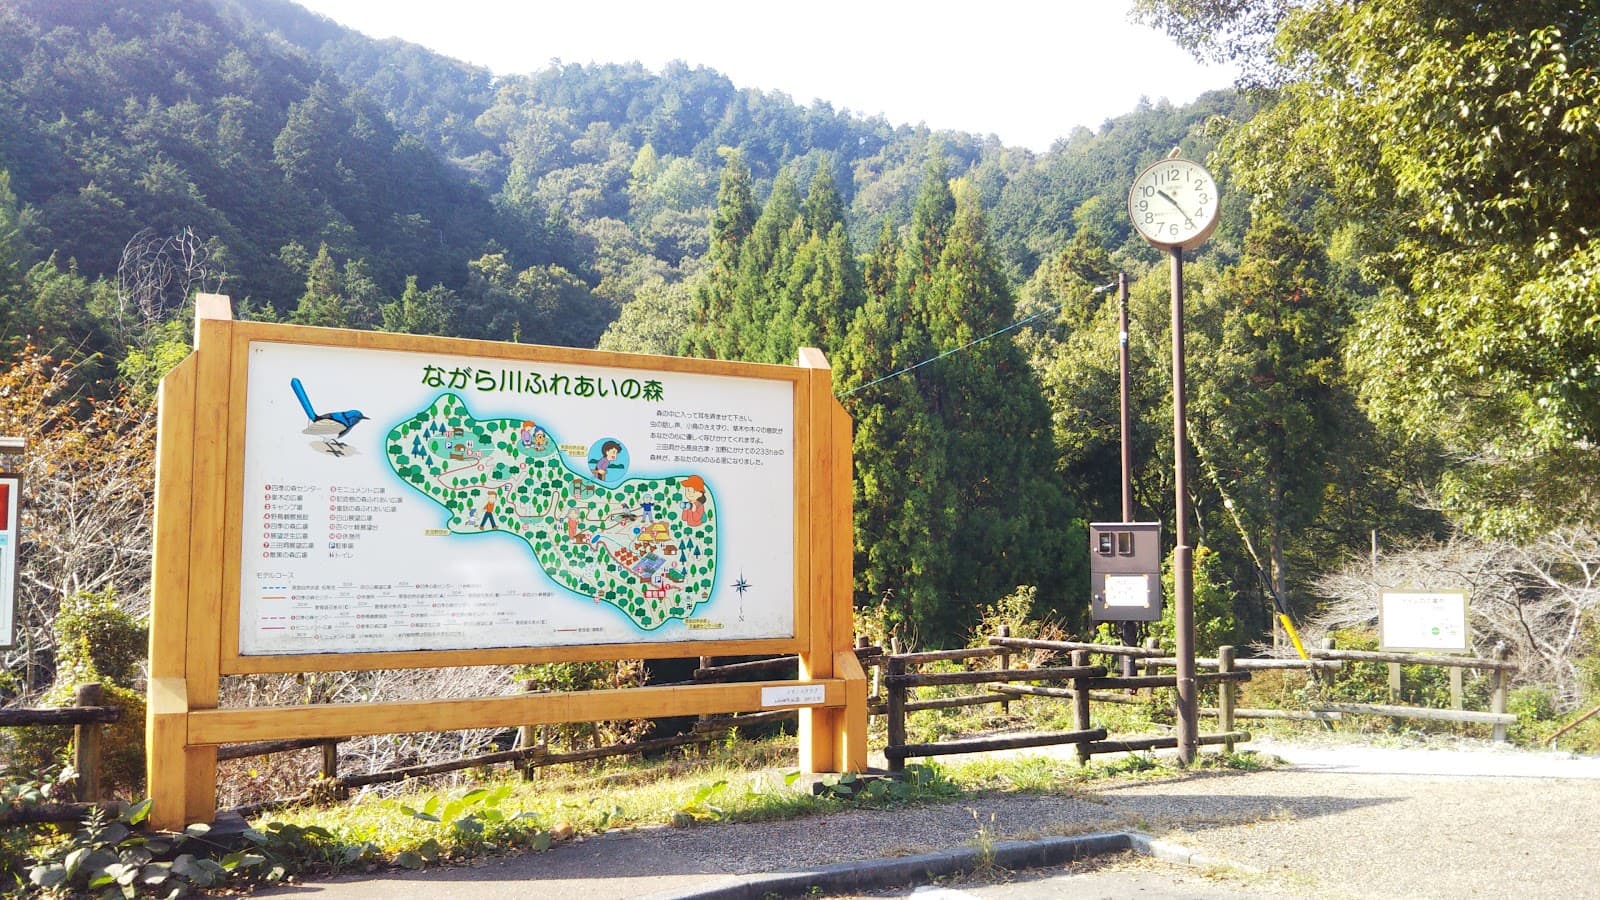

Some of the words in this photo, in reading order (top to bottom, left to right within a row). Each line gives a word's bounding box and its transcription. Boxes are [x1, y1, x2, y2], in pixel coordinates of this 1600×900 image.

[1154, 174, 1163, 186] 11
[1167, 169, 1180, 181] 12
[1186, 169, 1190, 182] 1
[1194, 179, 1204, 191] 2
[1142, 186, 1155, 198] 10
[1199, 193, 1208, 205] 3
[1139, 200, 1148, 212] 9
[1145, 212, 1154, 224] 8
[1195, 208, 1204, 218] 4
[1156, 222, 1165, 234] 7
[1169, 224, 1179, 236] 6
[1184, 219, 1193, 230] 5
[421, 364, 665, 402] ながら川ふれあいの森
